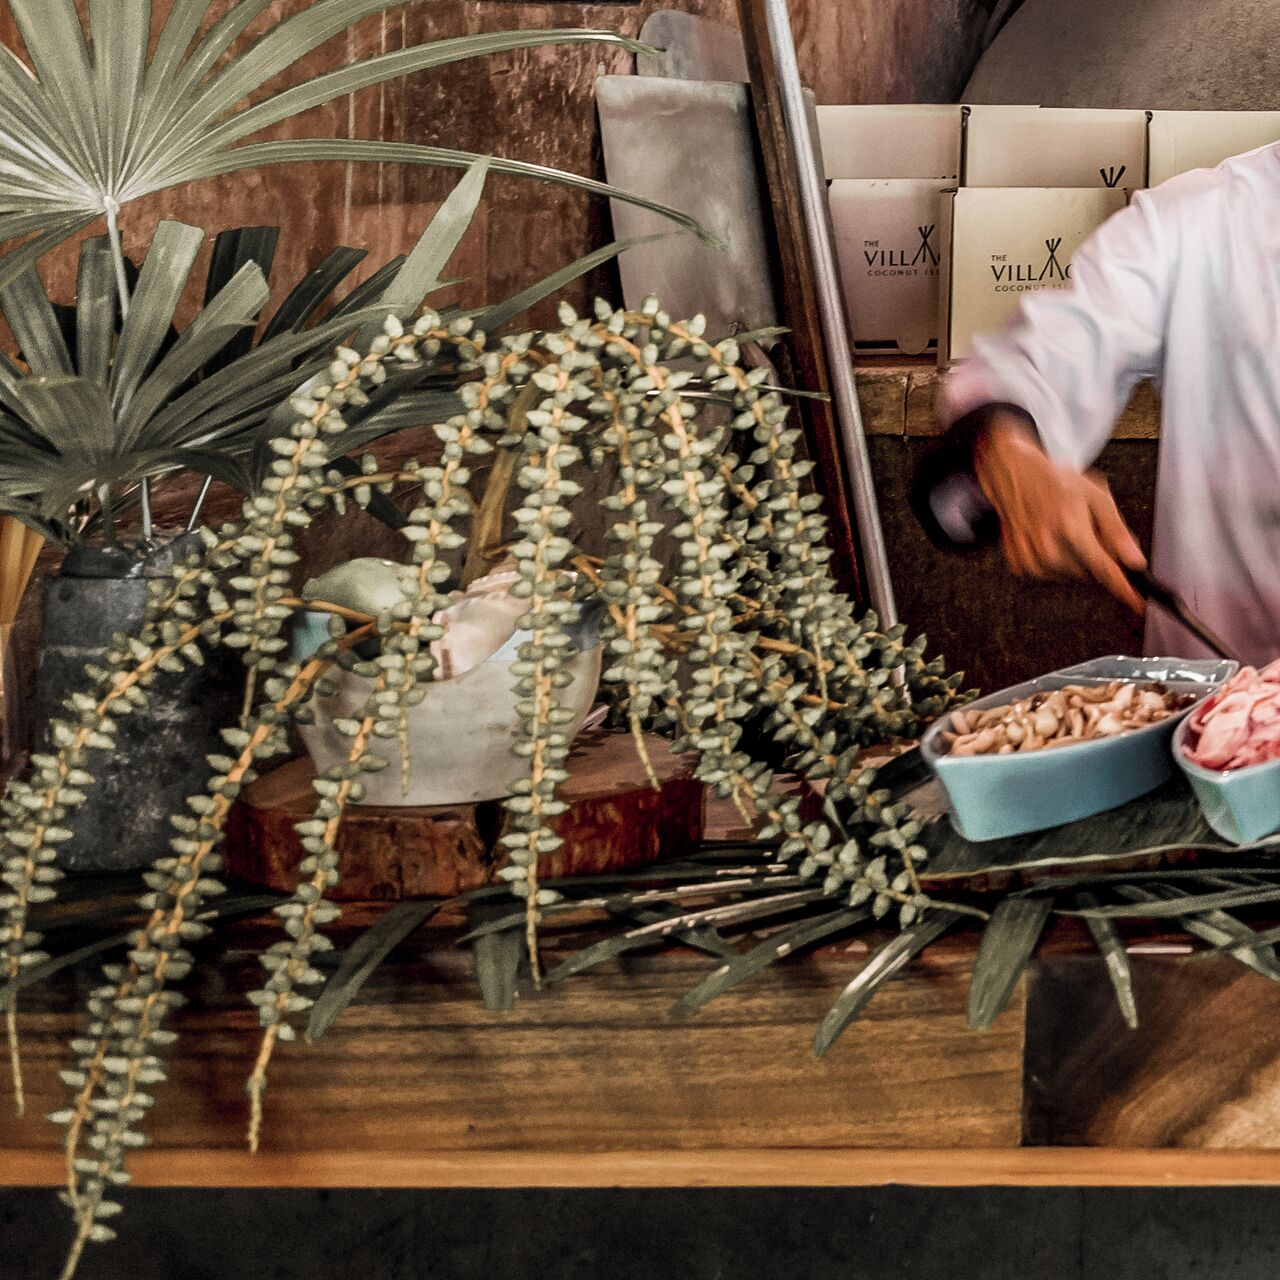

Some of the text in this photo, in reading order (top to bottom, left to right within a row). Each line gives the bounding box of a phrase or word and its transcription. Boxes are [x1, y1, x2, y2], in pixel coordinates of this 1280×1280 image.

[864, 240, 879, 248] THE
[864, 224, 941, 266] VILLA
[867, 269, 918, 277] COCONUT
[994, 284, 1046, 292] COCONUT
